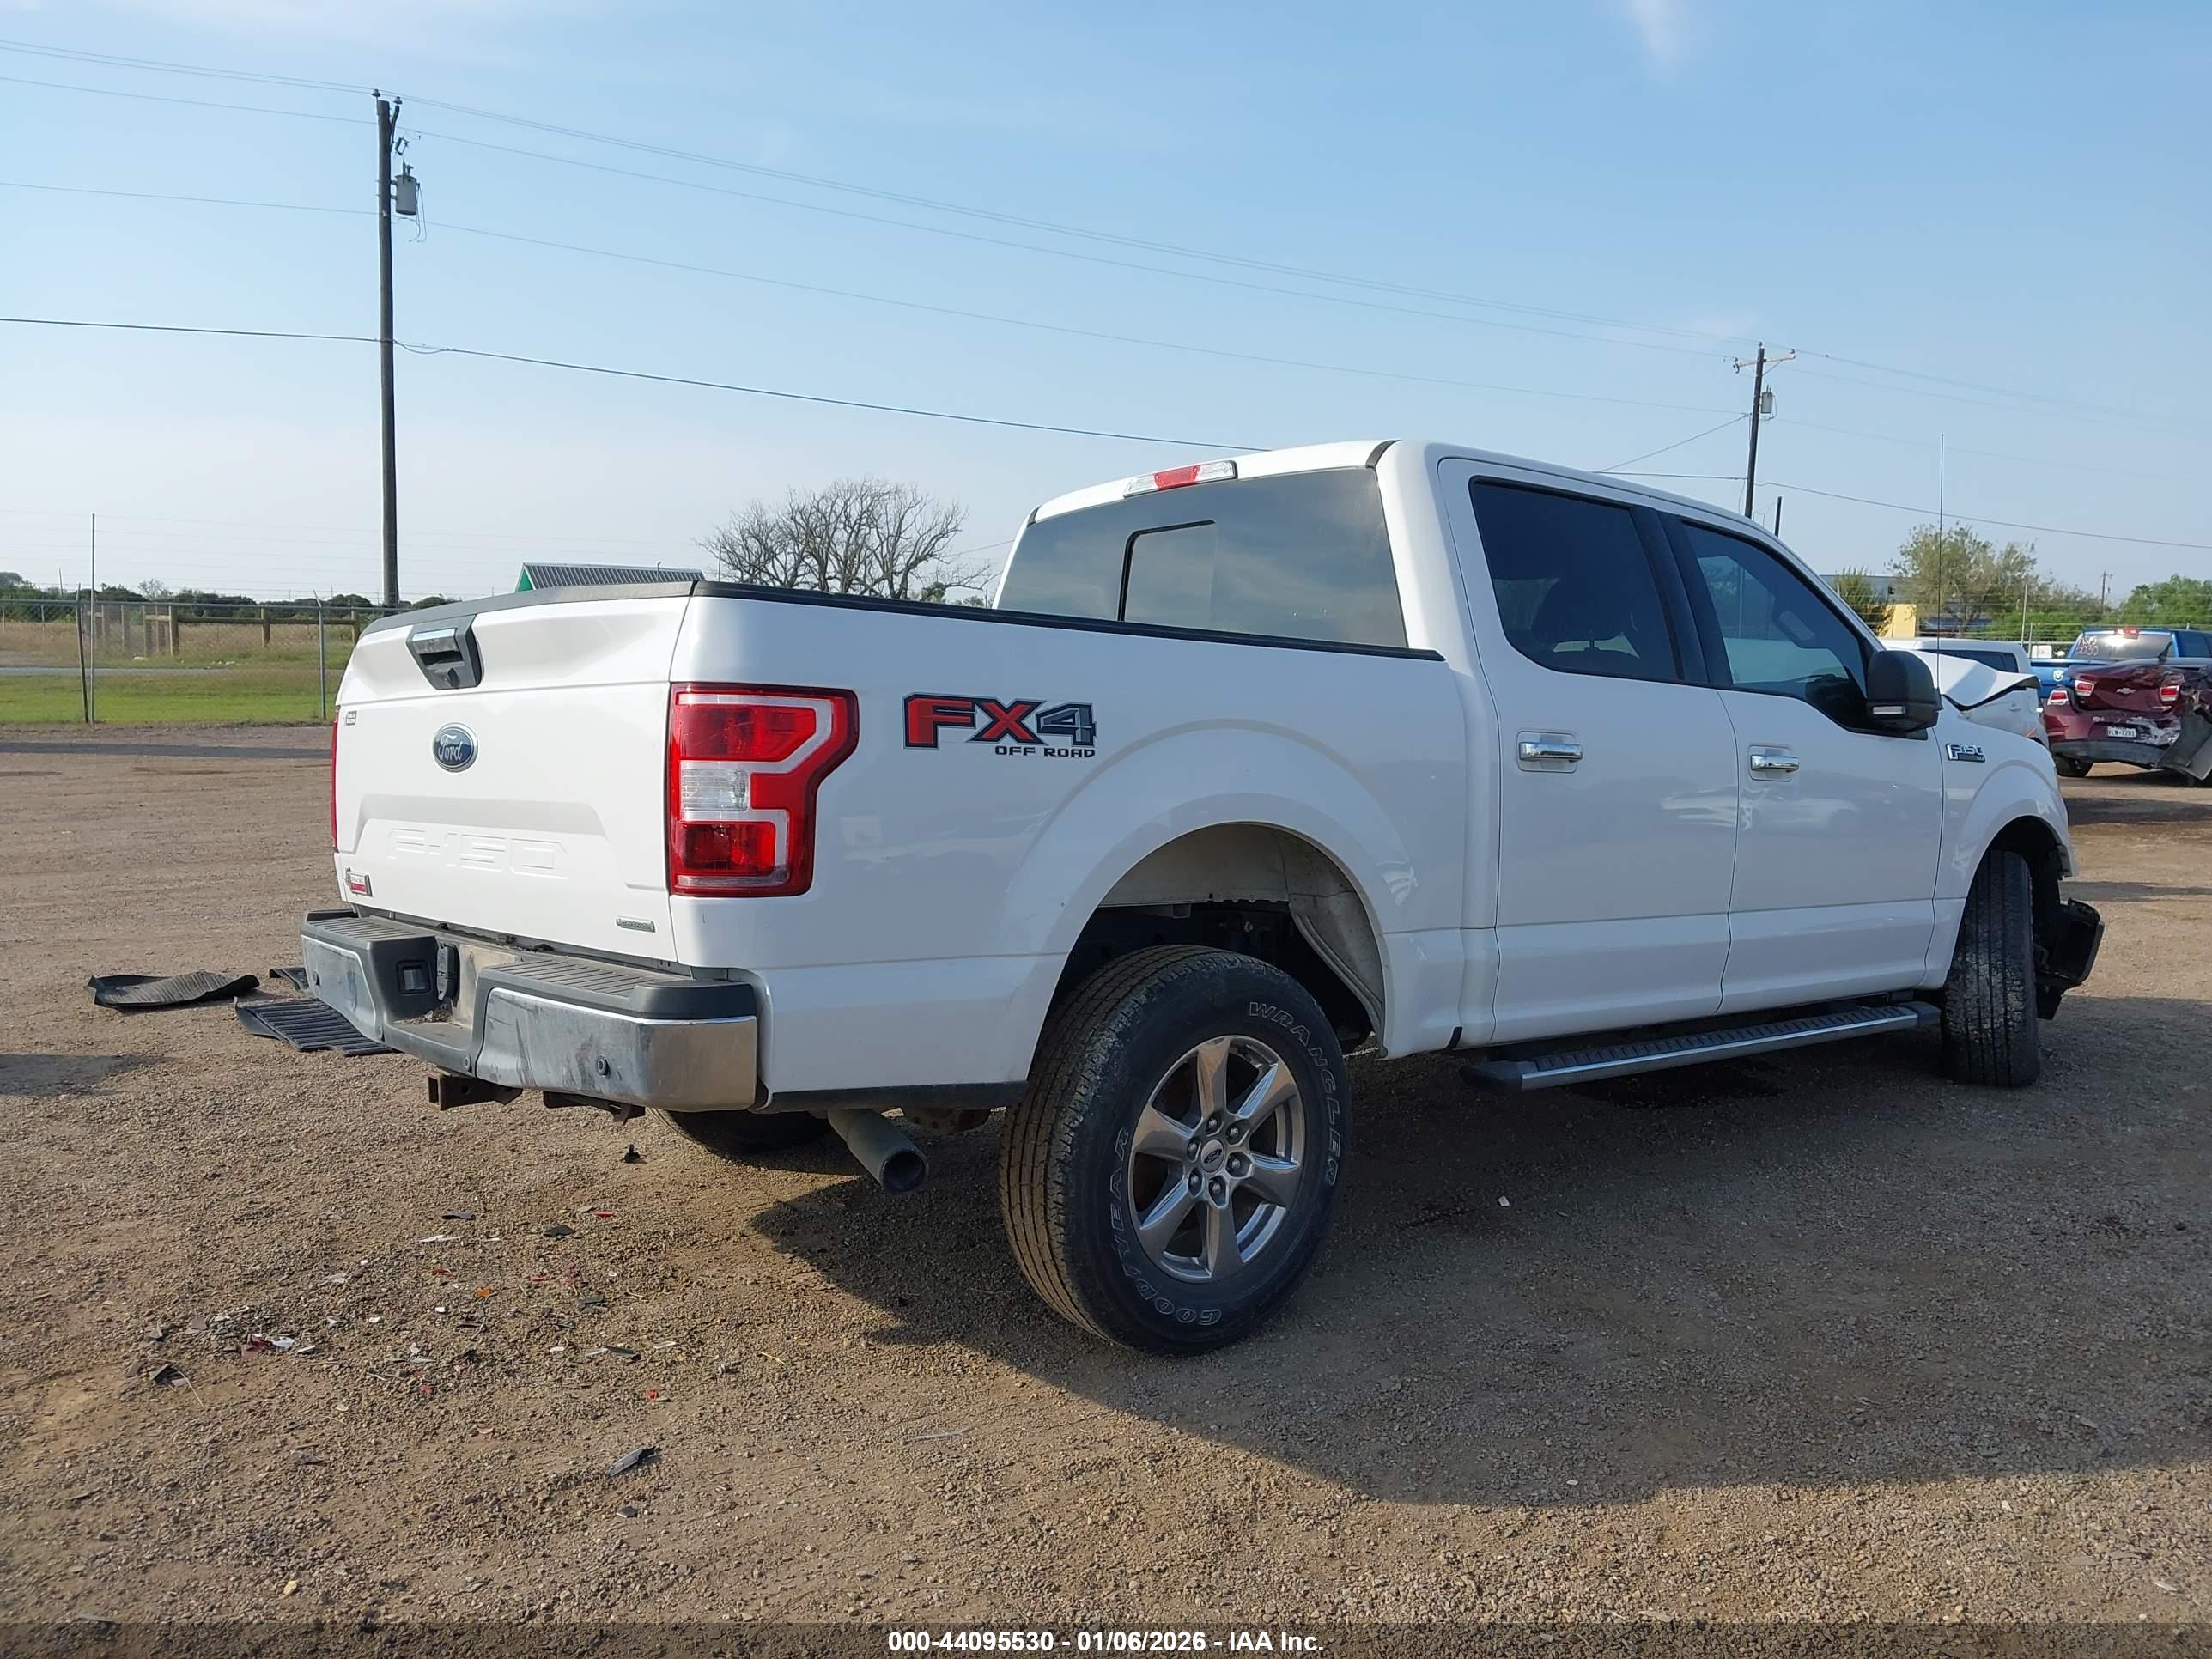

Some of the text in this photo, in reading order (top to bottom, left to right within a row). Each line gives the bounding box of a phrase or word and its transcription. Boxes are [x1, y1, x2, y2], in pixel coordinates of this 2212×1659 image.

[438, 734, 464, 761] Ford
[902, 691, 1097, 750] FX4
[995, 745, 1096, 758] OFF ROAD
[385, 827, 568, 880] F-150
[1249, 1001, 1343, 1187] WRANGLER
[1109, 1127, 1222, 1327] GOODYEAR
